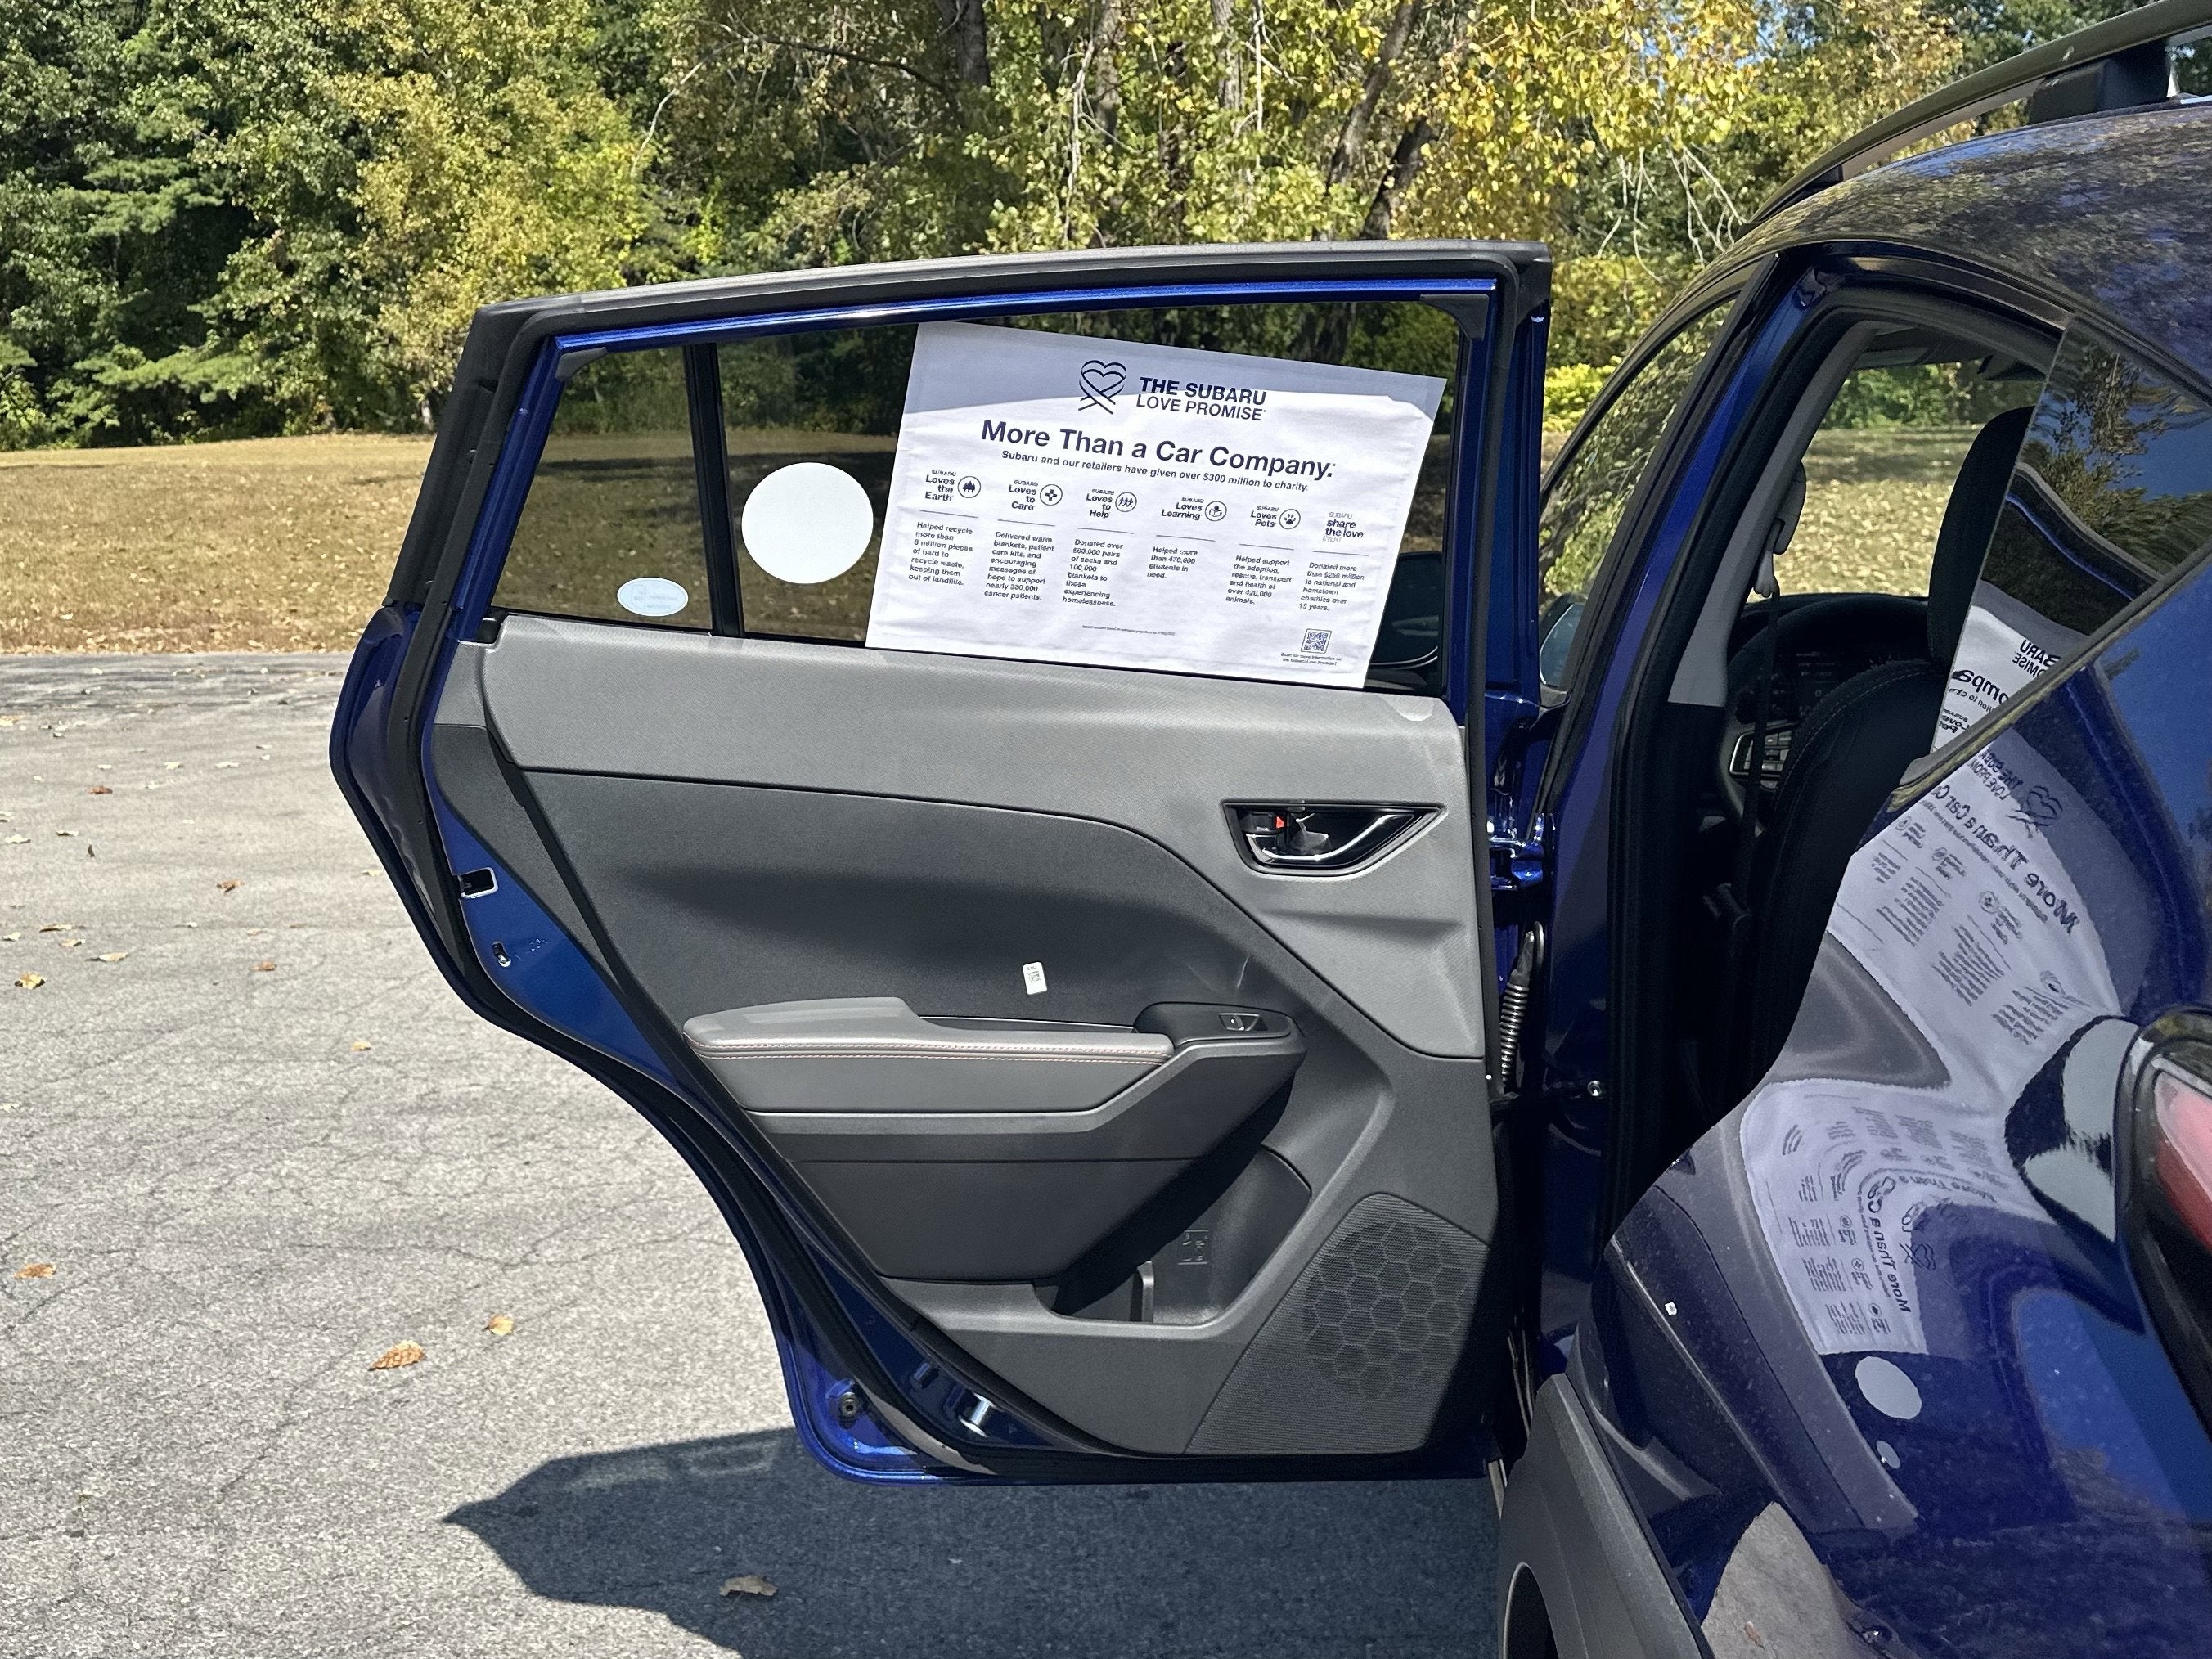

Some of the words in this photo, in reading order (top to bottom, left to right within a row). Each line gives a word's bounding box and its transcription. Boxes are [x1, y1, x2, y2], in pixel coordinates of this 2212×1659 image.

[1140, 376, 1180, 395] THE
[1185, 382, 1267, 406] SUBARU
[1135, 394, 1181, 412] LOVE
[1185, 401, 1262, 421] PROMISE
[981, 419, 1050, 447] More
[1060, 428, 1124, 456] Than
[1131, 443, 1147, 458] a
[1156, 440, 1203, 464] Car
[1209, 446, 1333, 481] Company.
[1002, 450, 1038, 459] Subaru
[1041, 456, 1060, 465] and
[1063, 459, 1080, 467] our
[1081, 461, 1122, 472] retailers
[1124, 465, 1148, 475] have
[1150, 468, 1176, 478] given
[1179, 471, 1200, 479] over
[1203, 472, 1226, 483] $300
[1228, 476, 1261, 487] million
[1263, 479, 1272, 488] to
[1275, 481, 1308, 492] charity.
[925, 474, 955, 485] Loves
[937, 484, 954, 493] the
[1008, 484, 1036, 496] Loves
[924, 491, 952, 501] Earth
[1026, 495, 1036, 503] to
[1086, 493, 1113, 503] Loves
[1011, 501, 1034, 510] Care
[1176, 502, 1203, 511] Loves
[1089, 510, 1110, 519] Help
[1161, 509, 1201, 521] Learning
[1250, 510, 1277, 520] Loves
[917, 522, 943, 531] Helped
[946, 526, 973, 534] recycle
[1255, 519, 1275, 528] Pets
[1326, 519, 1356, 528] share
[995, 531, 1031, 541] Delivered
[1325, 528, 1342, 537] the
[1342, 528, 1364, 538] love
[920, 540, 946, 549] million
[948, 543, 973, 552] pieces
[993, 540, 1027, 550] blankets,
[1075, 539, 1105, 547] Donated
[1153, 546, 1178, 555] Helped
[911, 557, 938, 565] recycle
[940, 560, 964, 569] waste,
[991, 558, 1036, 568] encouraging
[1235, 555, 1261, 564] Helped
[910, 564, 940, 575] keeping
[989, 566, 1026, 574] messages
[1247, 565, 1279, 574] adoption,
[1309, 562, 1338, 570] Donated
[987, 573, 1006, 582] hope
[1068, 572, 1098, 581] blankets
[1259, 574, 1292, 582] transport
[986, 582, 1009, 591] nearly
[1303, 587, 1338, 595] hometown
[1063, 589, 1110, 599] experiencing
[1062, 596, 1116, 606] homelessness.
